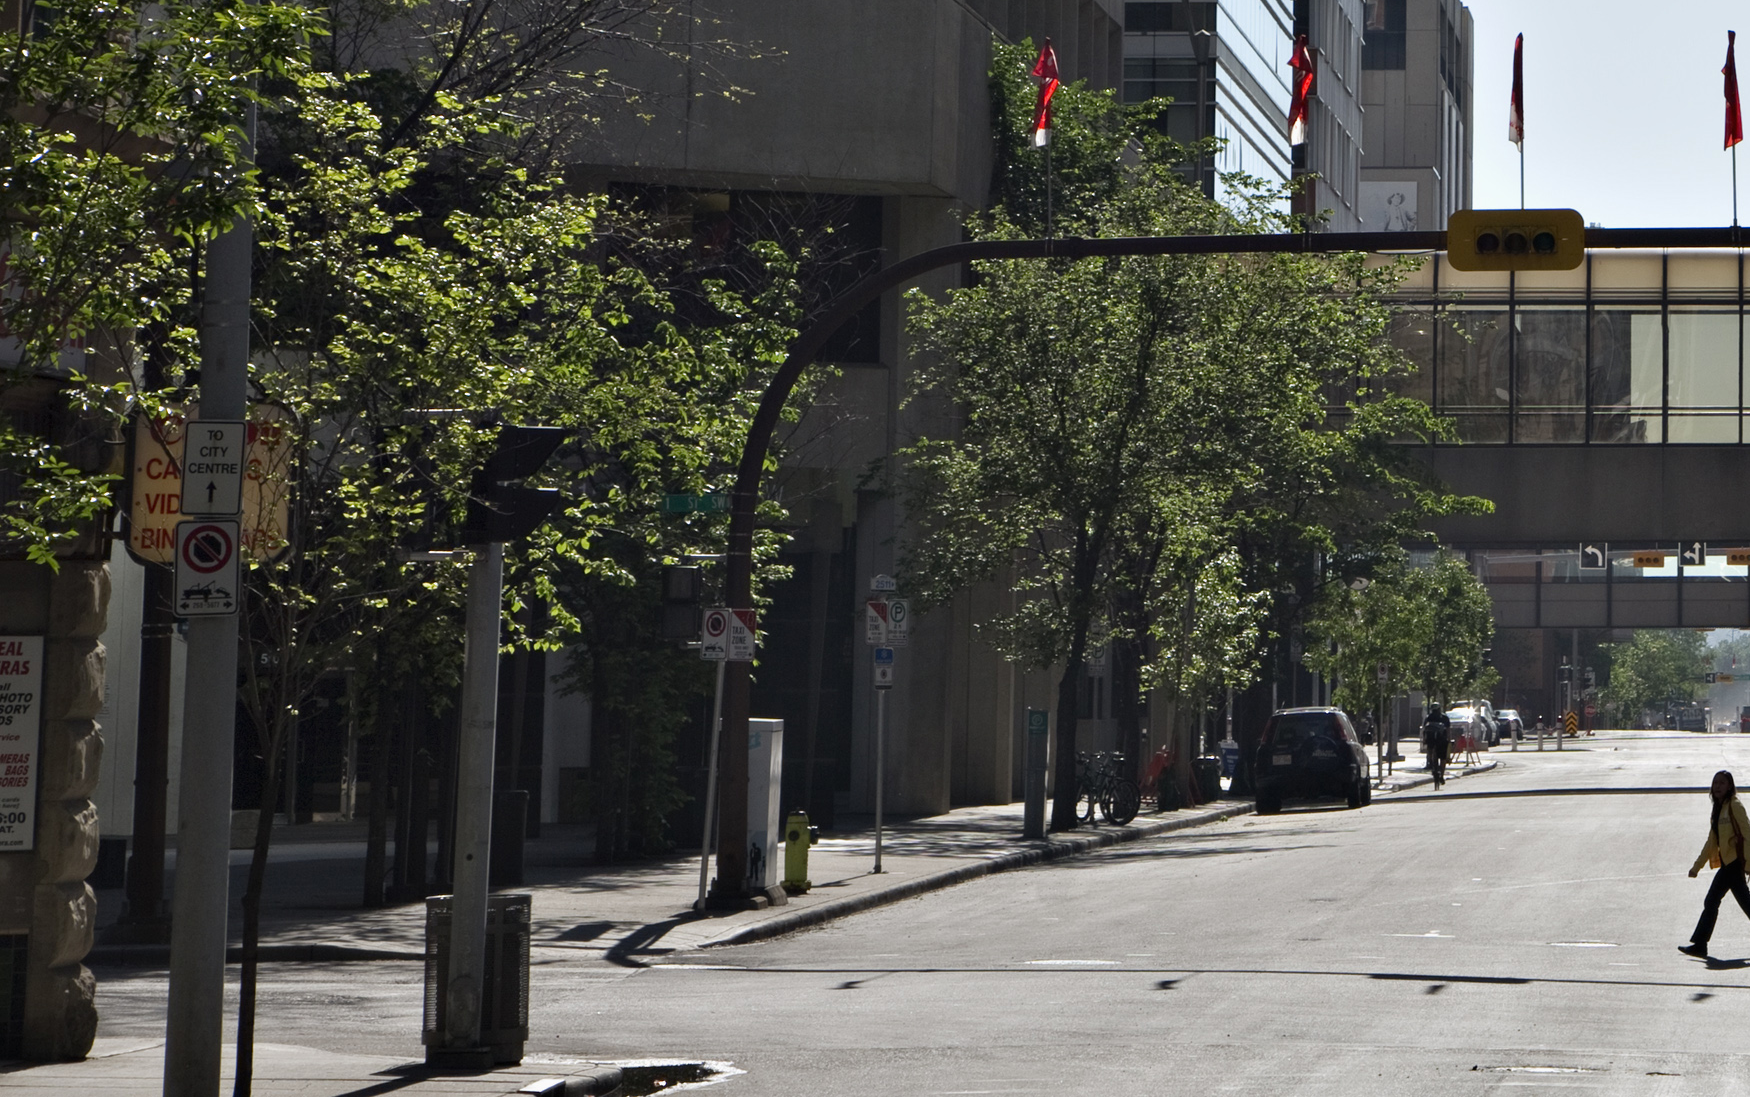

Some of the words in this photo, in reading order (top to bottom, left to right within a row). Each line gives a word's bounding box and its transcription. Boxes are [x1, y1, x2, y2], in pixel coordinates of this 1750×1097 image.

[207, 429, 224, 441] TO
[200, 446, 228, 457] CITY
[188, 463, 238, 474] CENTRE
[145, 493, 180, 514] VID
[687, 496, 699, 509] ST
[711, 496, 725, 509] SW
[732, 626, 745, 636] TAXI
[731, 635, 747, 645] ZONE
[0, 660, 30, 675] RAS
[4, 765, 29, 775] BAGS
